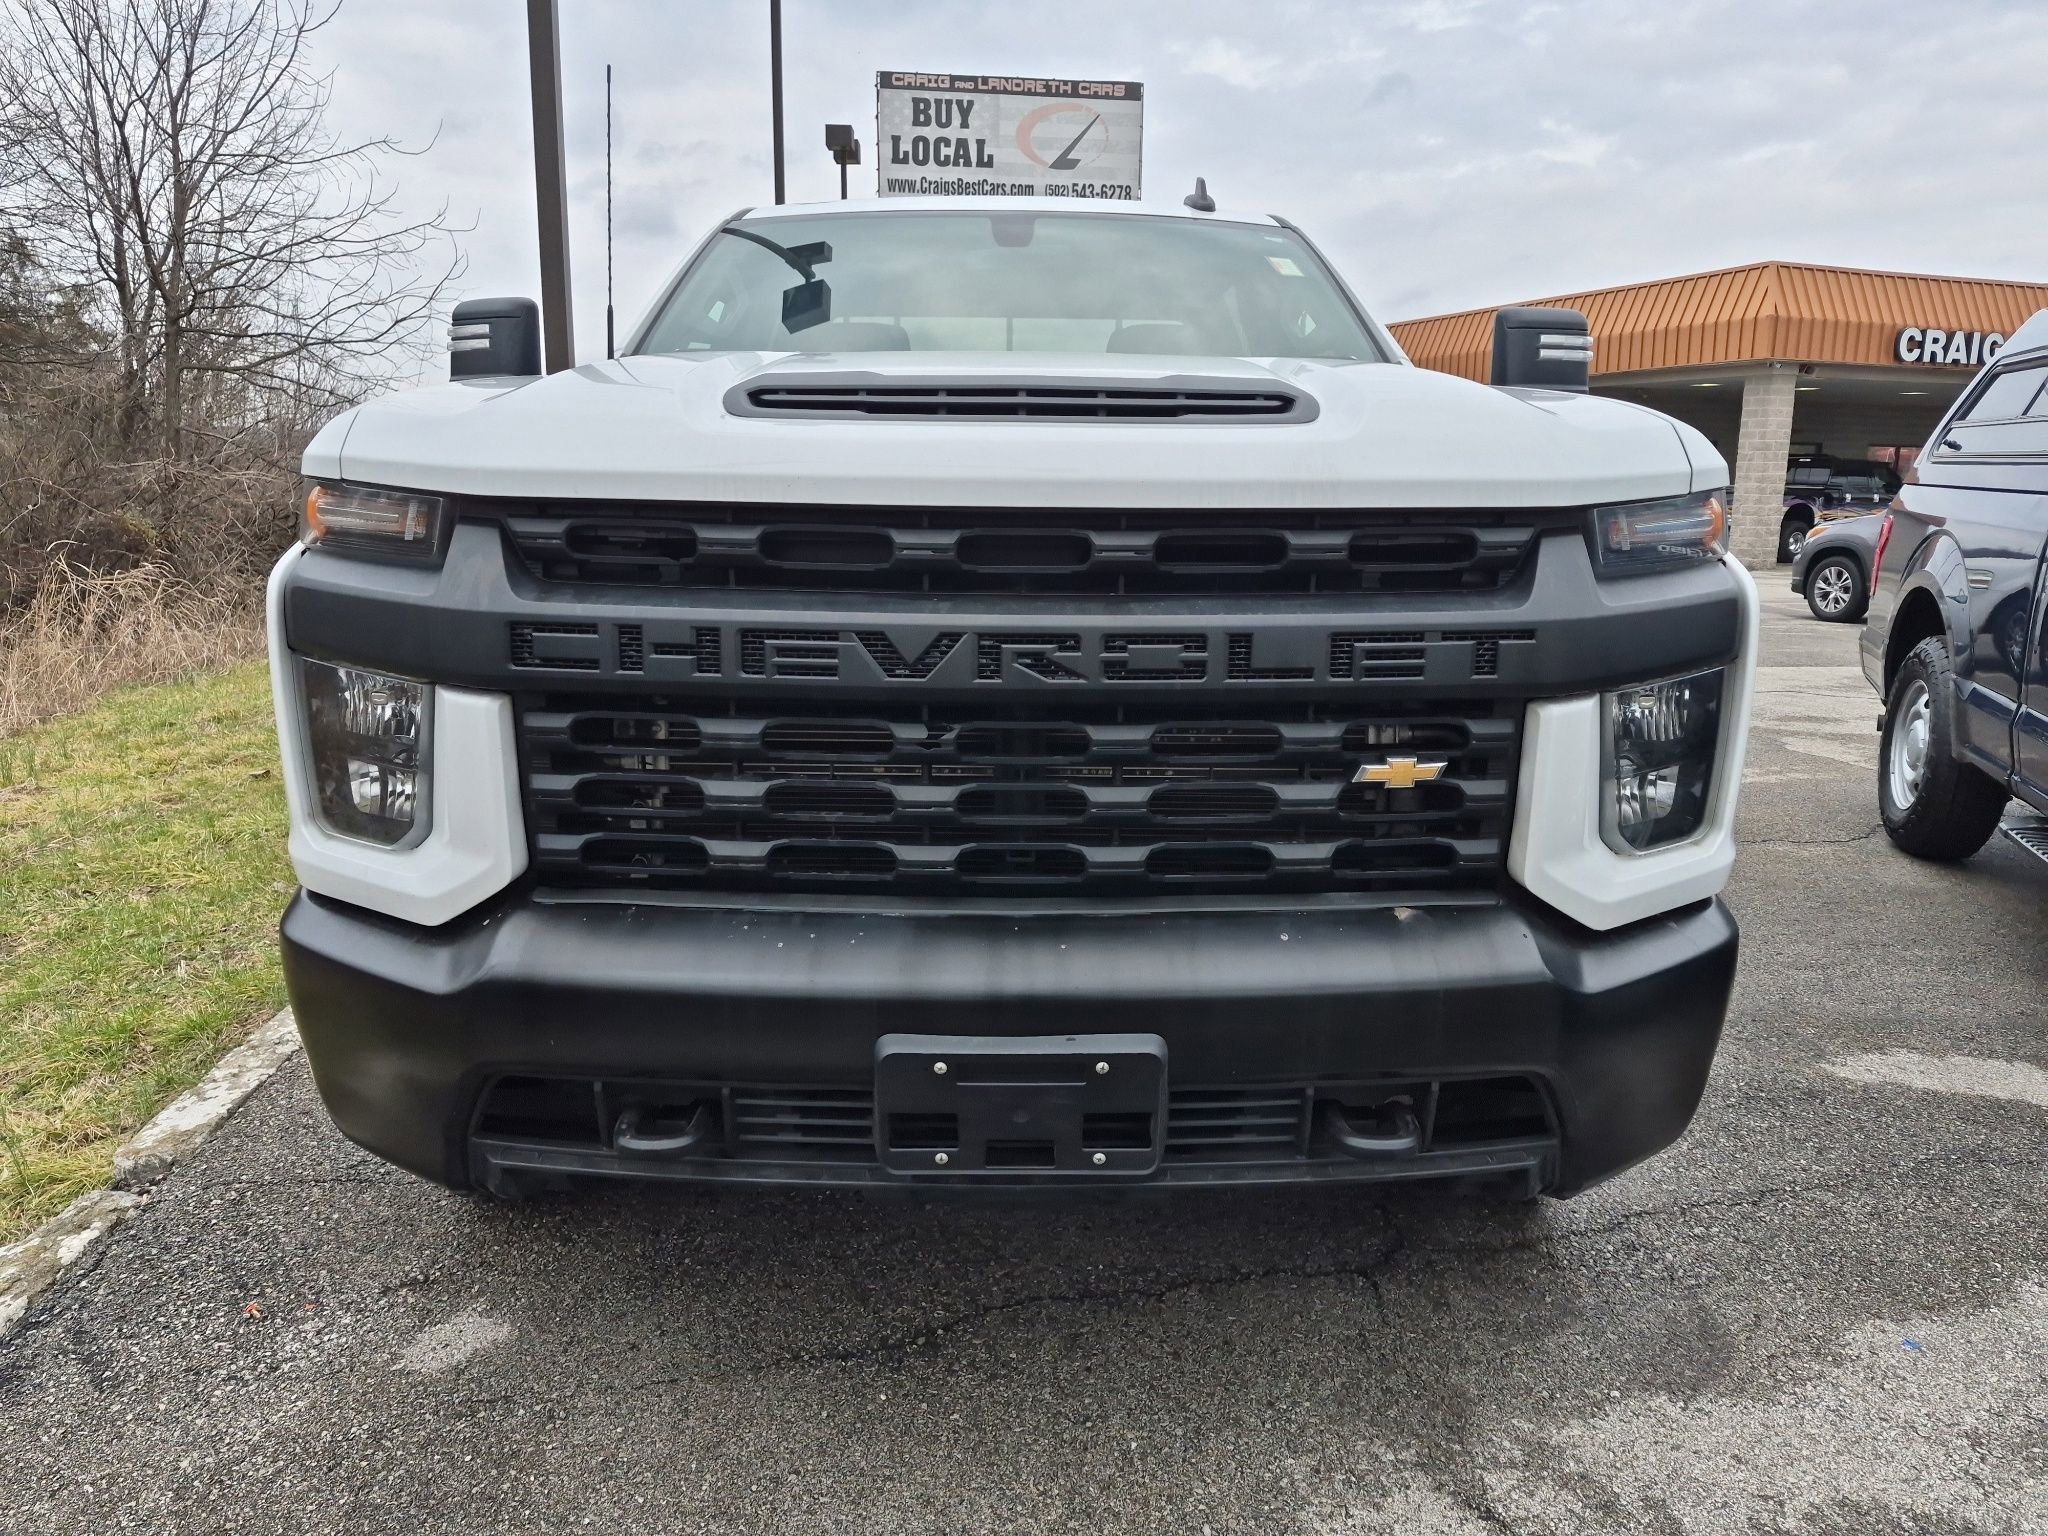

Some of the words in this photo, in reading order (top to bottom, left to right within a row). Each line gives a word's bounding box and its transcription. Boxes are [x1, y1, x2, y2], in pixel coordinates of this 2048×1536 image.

[891, 73, 950, 88] CRAIG
[954, 80, 975, 90] AND
[977, 77, 1072, 94] LANDRETH
[1078, 81, 1126, 96] CARS
[911, 96, 975, 129] BUY
[890, 134, 994, 169] LOCAL
[887, 176, 1035, 197] www.CraigsBestCars.com
[1044, 184, 1070, 198] (502)
[1071, 182, 1132, 200] 543-6278
[509, 620, 1537, 683] CHEVROLET
